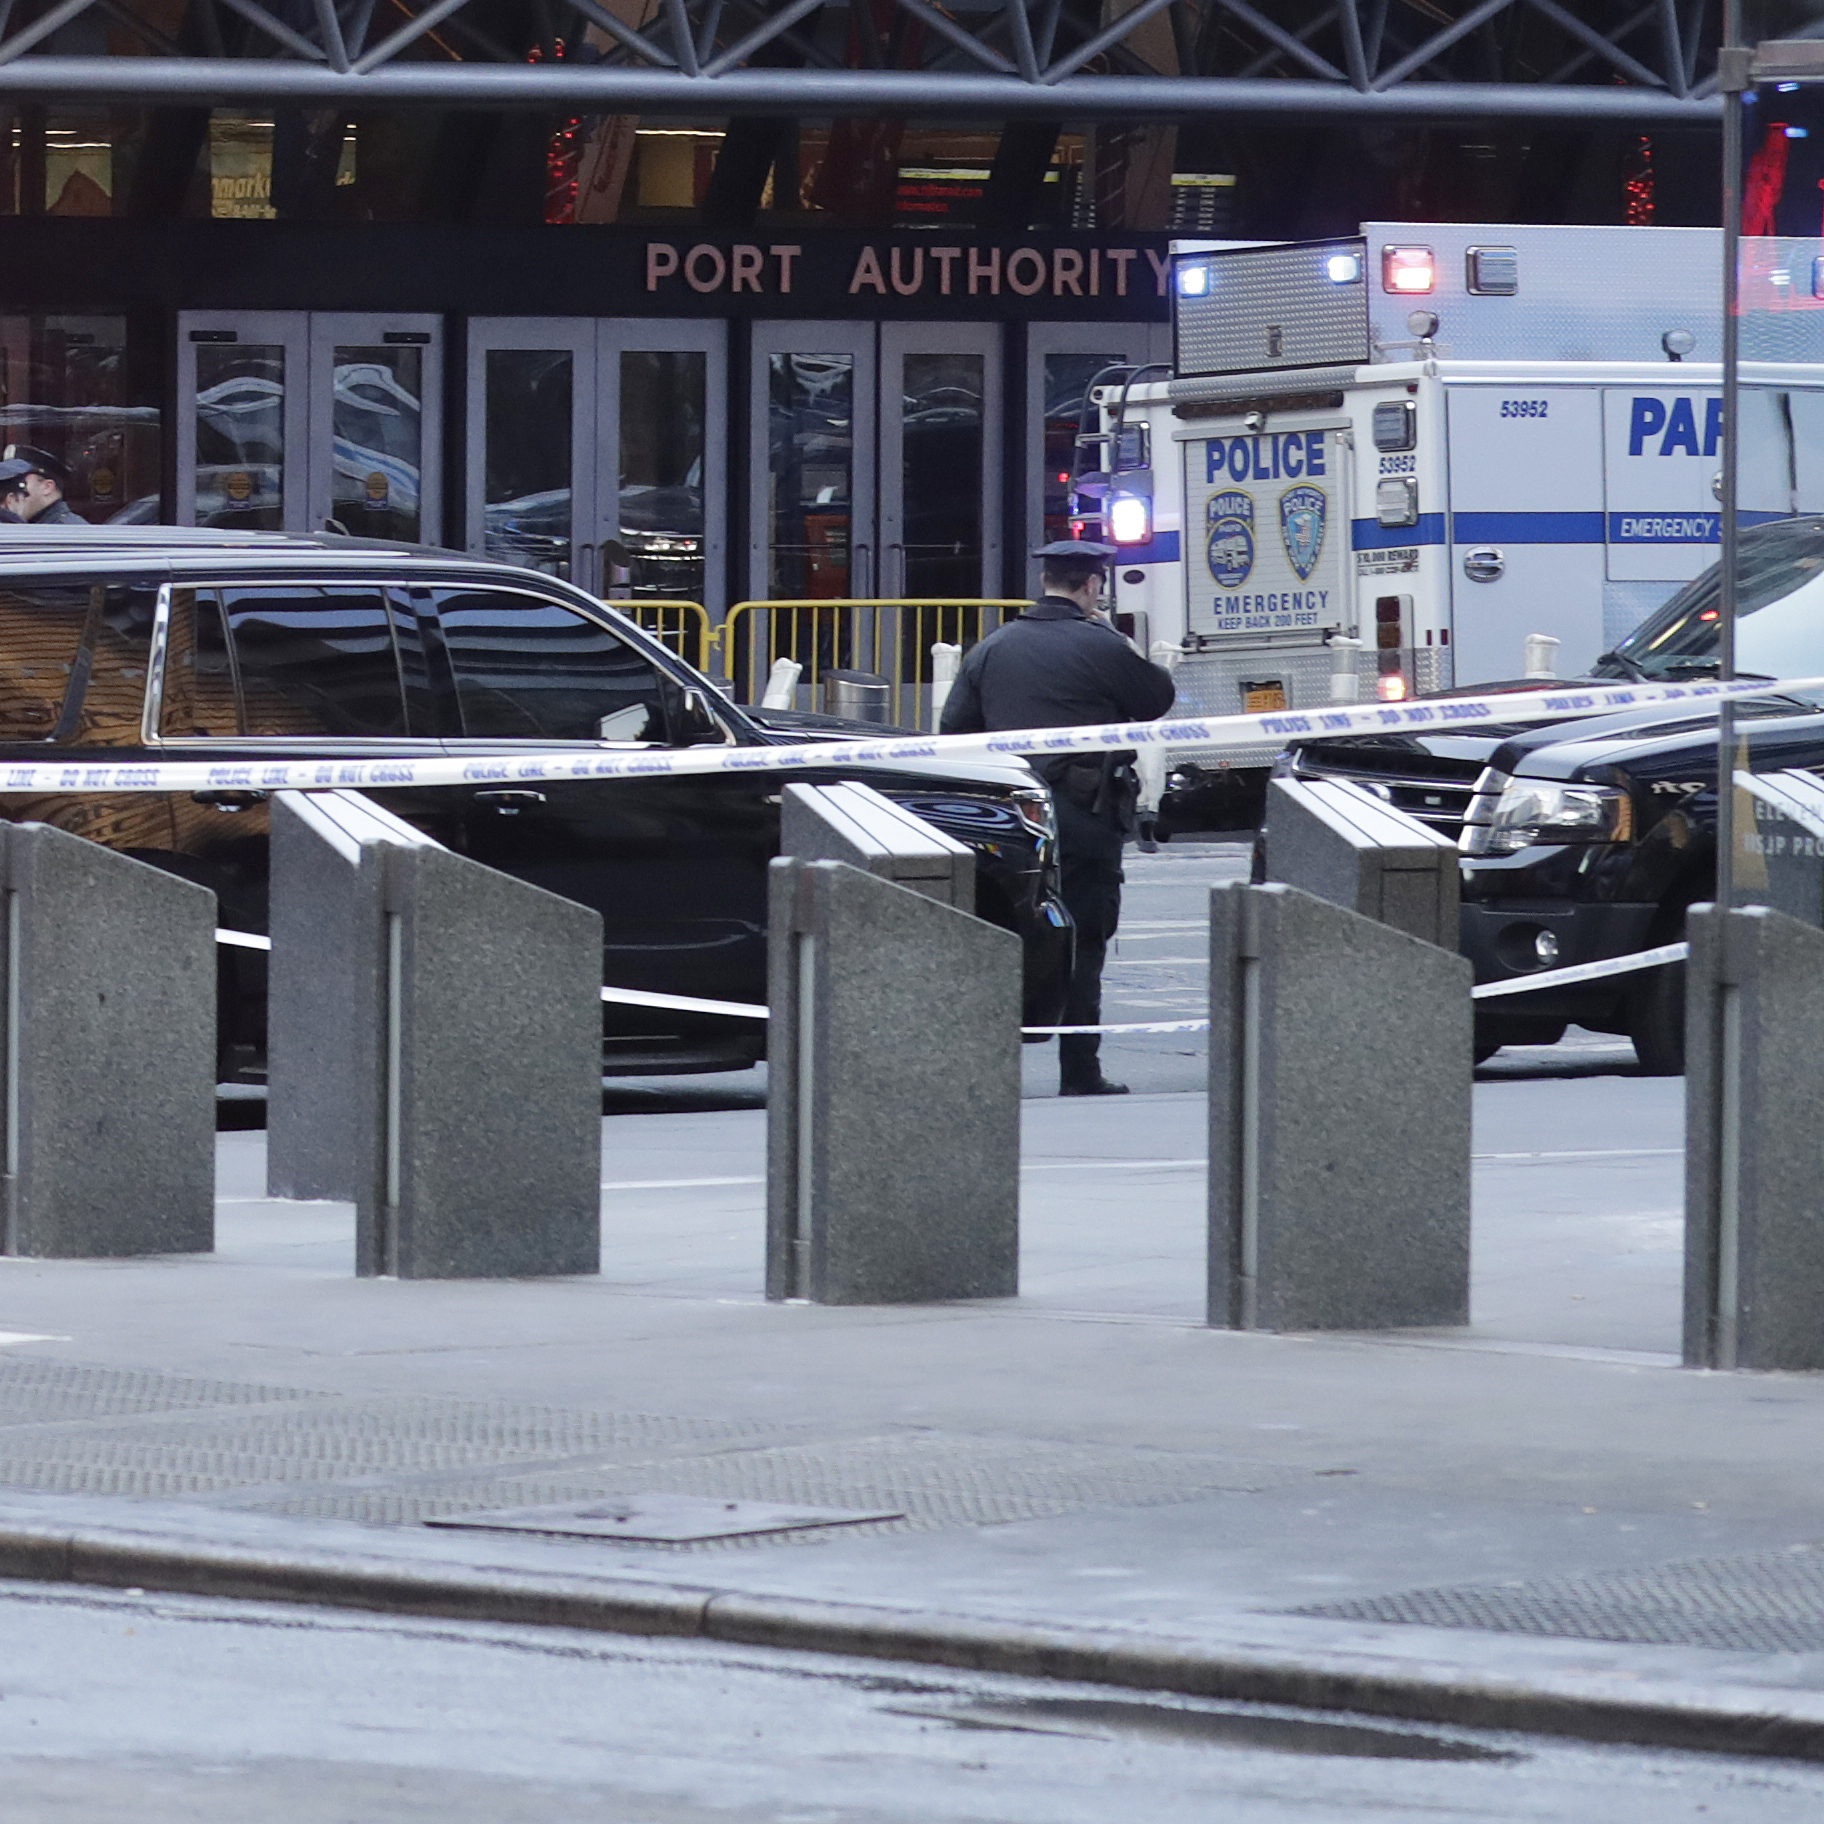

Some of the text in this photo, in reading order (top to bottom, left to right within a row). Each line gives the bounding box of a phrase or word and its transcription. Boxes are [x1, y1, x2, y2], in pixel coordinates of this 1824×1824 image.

[646, 242, 1170, 297] PORT AUTHORITY
[1500, 400, 1548, 418] 53952
[1206, 432, 1326, 484] POLICE
[1209, 497, 1251, 518] POLICE
[1620, 518, 1715, 537] EMERGENCY
[1213, 590, 1329, 616] EMERGENCY
[1218, 613, 1318, 630] KEEP BACK 200 FEET
[1259, 702, 1492, 735] POLICE LINE DO NOT CROSS
